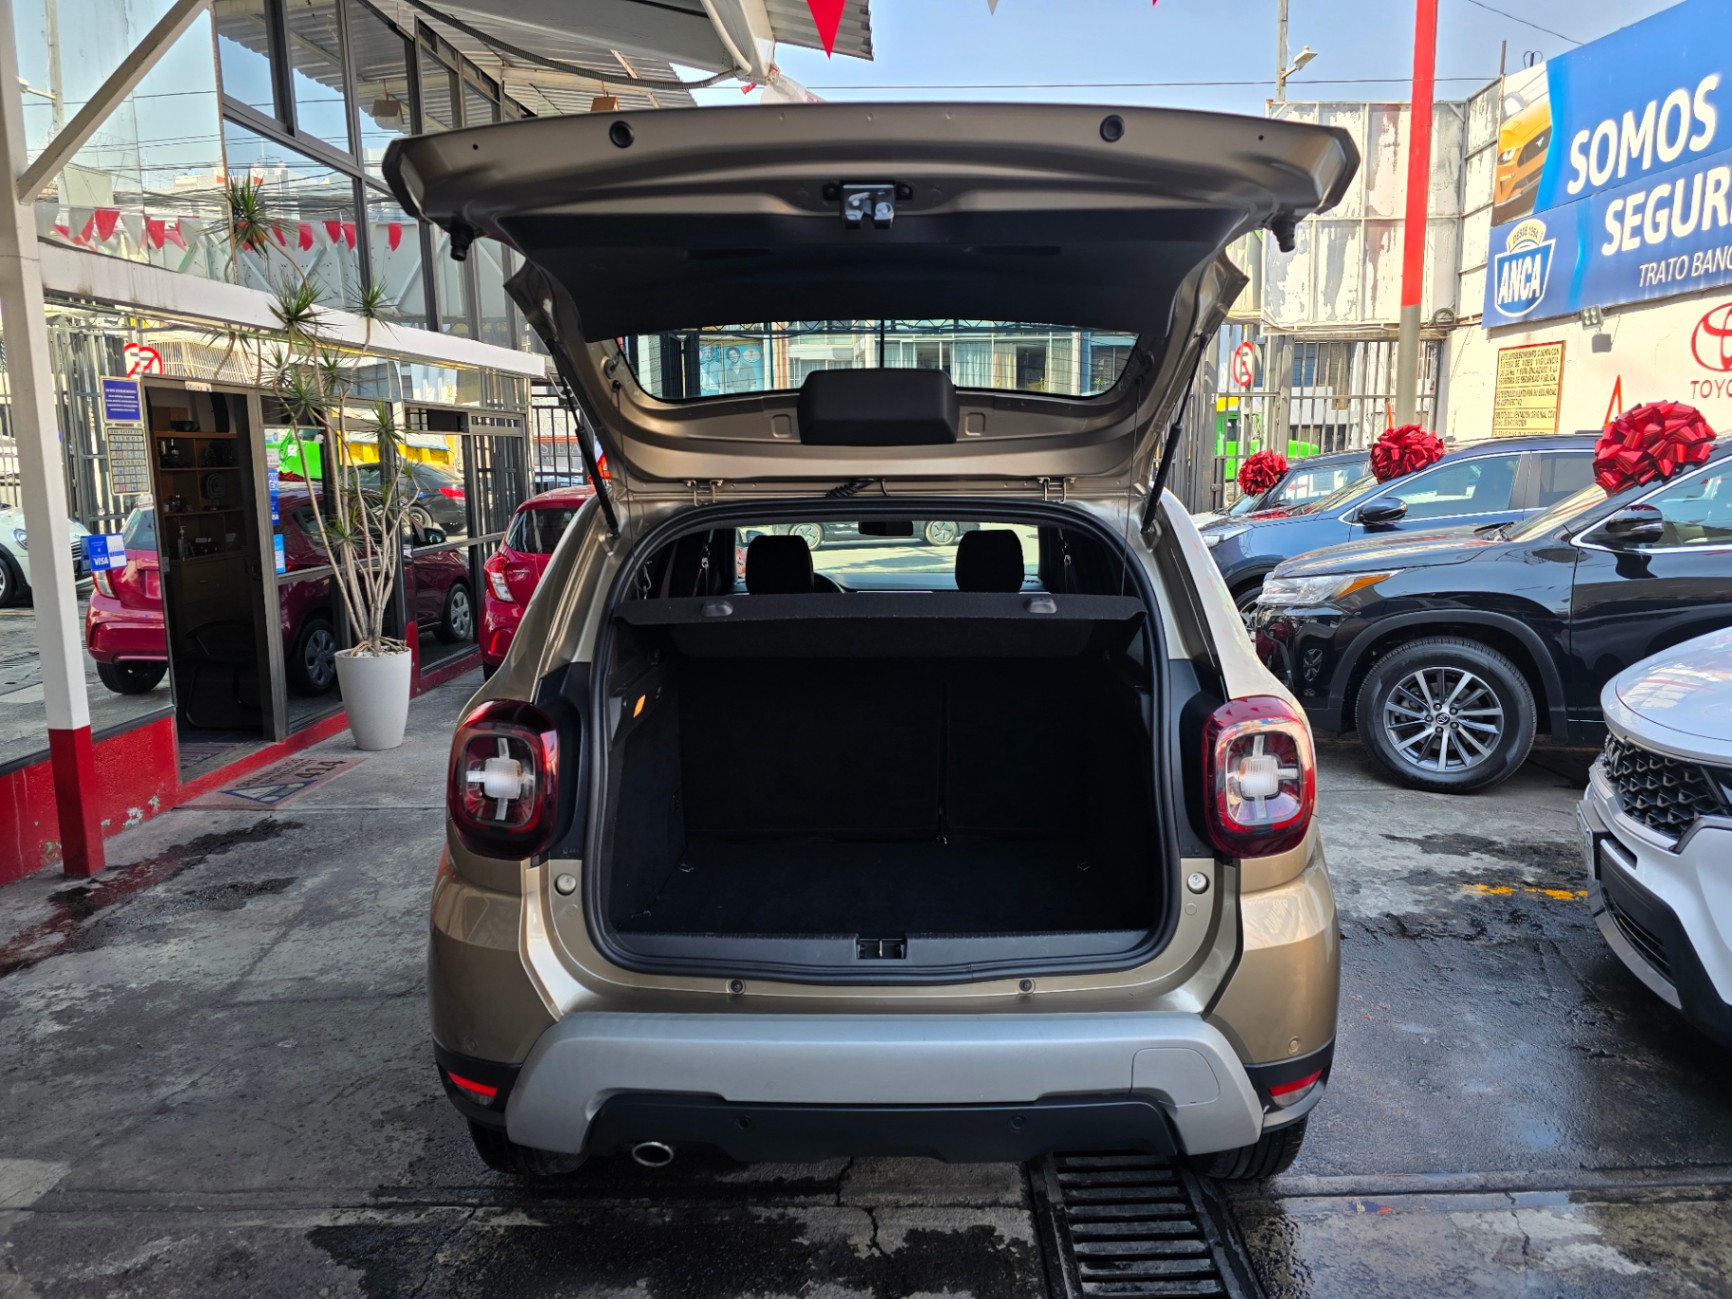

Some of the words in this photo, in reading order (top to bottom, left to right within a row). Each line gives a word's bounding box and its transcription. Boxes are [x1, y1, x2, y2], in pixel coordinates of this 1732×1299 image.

[1567, 73, 1720, 195] SOMOS
[1601, 166, 1732, 256] SEGUR
[1498, 253, 1541, 304] ANCA
[1639, 255, 1689, 288] TRATO
[93, 557, 109, 566] VISA
